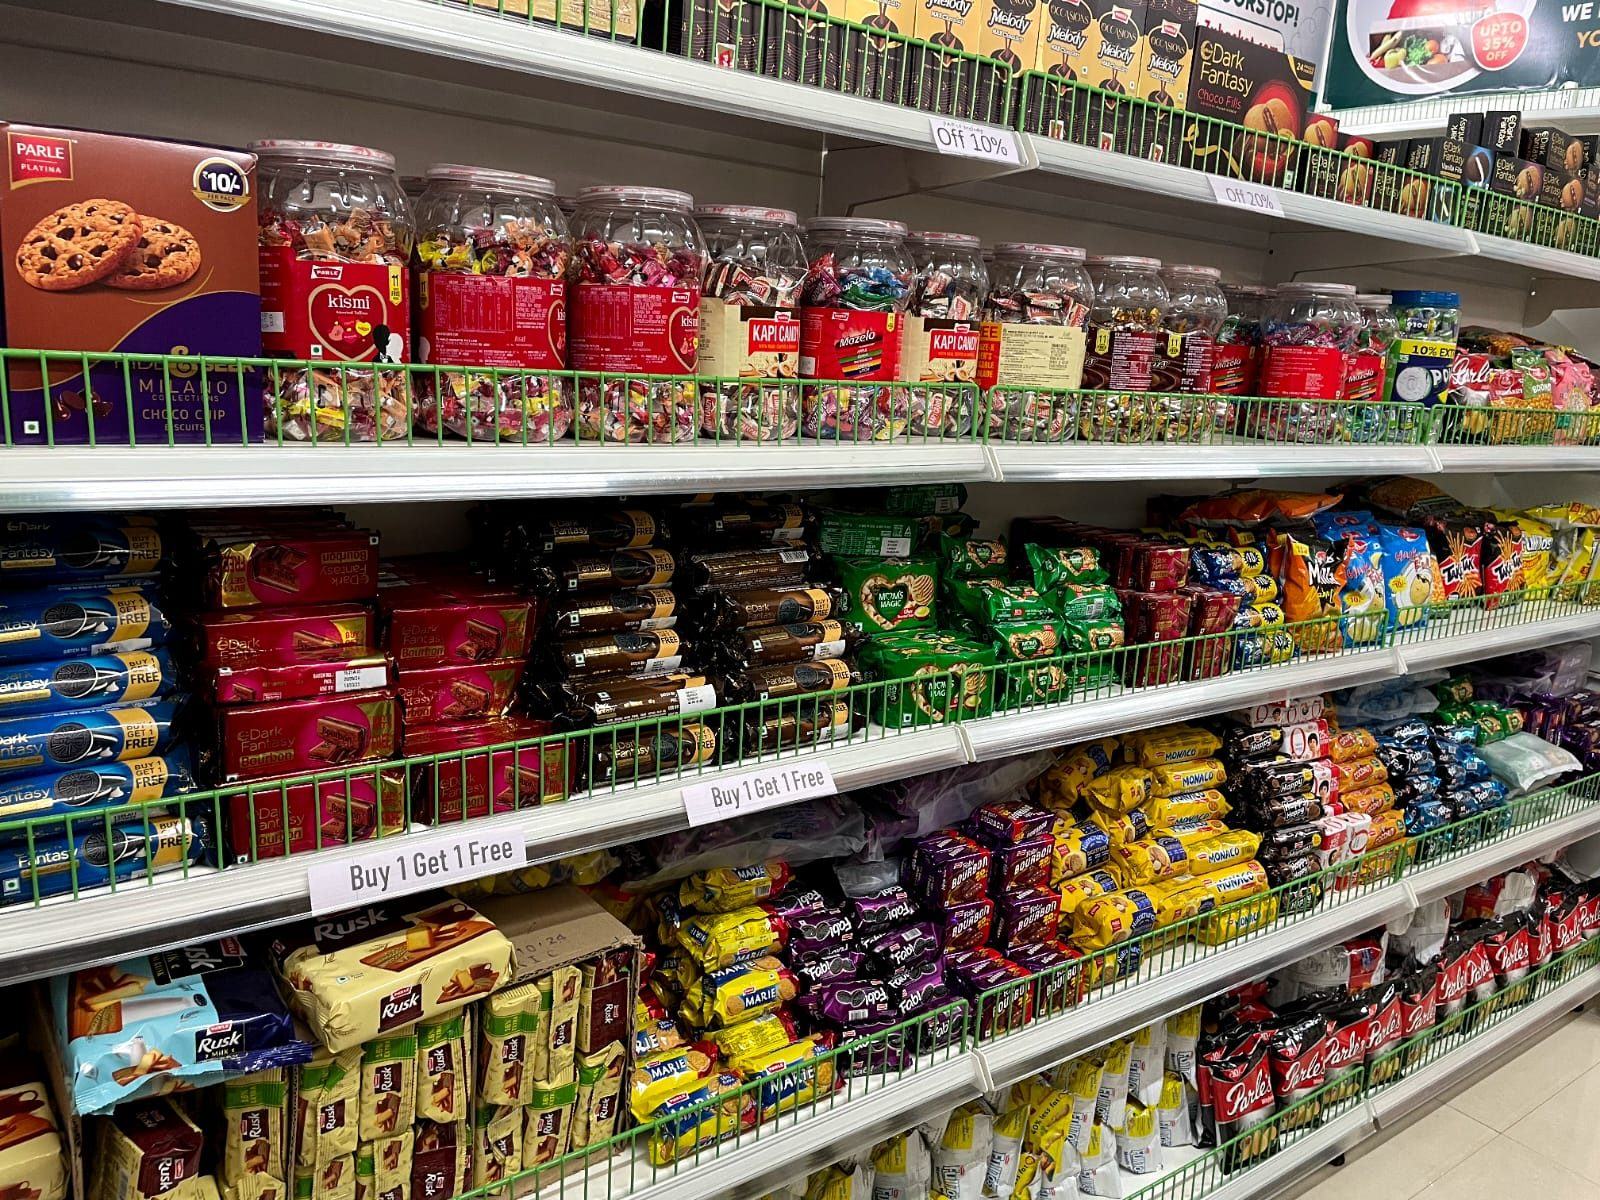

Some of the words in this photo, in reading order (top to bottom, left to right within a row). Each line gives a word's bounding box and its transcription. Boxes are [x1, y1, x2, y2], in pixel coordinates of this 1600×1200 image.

[988, 9, 1031, 33] Melody
[1562, 3, 1592, 22] WE
[1047, 24, 1087, 49] Melody
[1482, 37, 1516, 50] 35%
[1098, 41, 1134, 65] Melody
[1486, 50, 1507, 61] OFF
[1148, 54, 1182, 77] Melody
[1201, 62, 1253, 97] Fantasy
[1197, 88, 1224, 104] Choco
[1226, 96, 1241, 110] Fills
[16, 142, 65, 160] PARLE
[937, 127, 964, 149] Off
[971, 133, 1008, 156] 10%
[20, 163, 62, 174] PLATINA
[1226, 187, 1244, 203] Off
[1250, 191, 1274, 209] 20%
[327, 294, 371, 310] kismi
[752, 324, 777, 342] KAPI
[839, 330, 875, 347] Mazelo
[934, 334, 956, 350] KAPI
[1412, 345, 1438, 356] 10%
[131, 550, 161, 560] FREE
[656, 563, 674, 572] FREE
[657, 595, 674, 605] FREE
[881, 599, 902, 608] MAGIC
[119, 612, 149, 625] FREE
[661, 636, 678, 644] FREE
[130, 672, 160, 684] FREE
[833, 671, 850, 680] FREE
[126, 737, 155, 749] FREE
[1250, 738, 1272, 751] Happy
[240, 750, 295, 768] Bourbon
[1165, 748, 1196, 761] MONACO
[135, 762, 155, 770] BUY
[136, 775, 165, 788] FREE
[712, 785, 741, 808] Buy
[743, 781, 752, 801] 1
[755, 777, 781, 798] Get
[781, 772, 792, 792] 1
[794, 769, 825, 791] Free
[1182, 771, 1214, 787] MONACO
[1281, 778, 1304, 793] Happy
[350, 863, 391, 892] Buy
[396, 856, 407, 881] 1
[413, 849, 449, 877] Get
[453, 844, 464, 869] 1
[470, 837, 514, 866] Free
[1014, 843, 1052, 875] BOURBON
[1208, 847, 1240, 864] MONACO
[737, 864, 766, 880] MARIE
[951, 855, 988, 889] BOURBON
[314, 906, 389, 942] Rusk
[952, 905, 990, 938] BOURBON
[1018, 900, 1058, 933] BOURBON
[383, 993, 419, 1019] Rusk
[744, 987, 777, 1008] MARIE
[604, 1003, 614, 1025] Rusk
[197, 1030, 243, 1054] Rusk
[556, 1023, 566, 1046] Rusk
[508, 1038, 519, 1061] Rusk
[1323, 1030, 1366, 1065] Parle's
[435, 1049, 446, 1073] Rusk
[651, 1057, 686, 1082] MARIE
[381, 1066, 393, 1092] Rusk
[1226, 1068, 1273, 1116] Parle's
[326, 1103, 335, 1131] Rusk
[599, 1097, 609, 1119] Rusk
[249, 1112, 261, 1139] Rusk
[543, 1113, 554, 1134] Rusk
[158, 1157, 173, 1191] Rusk
